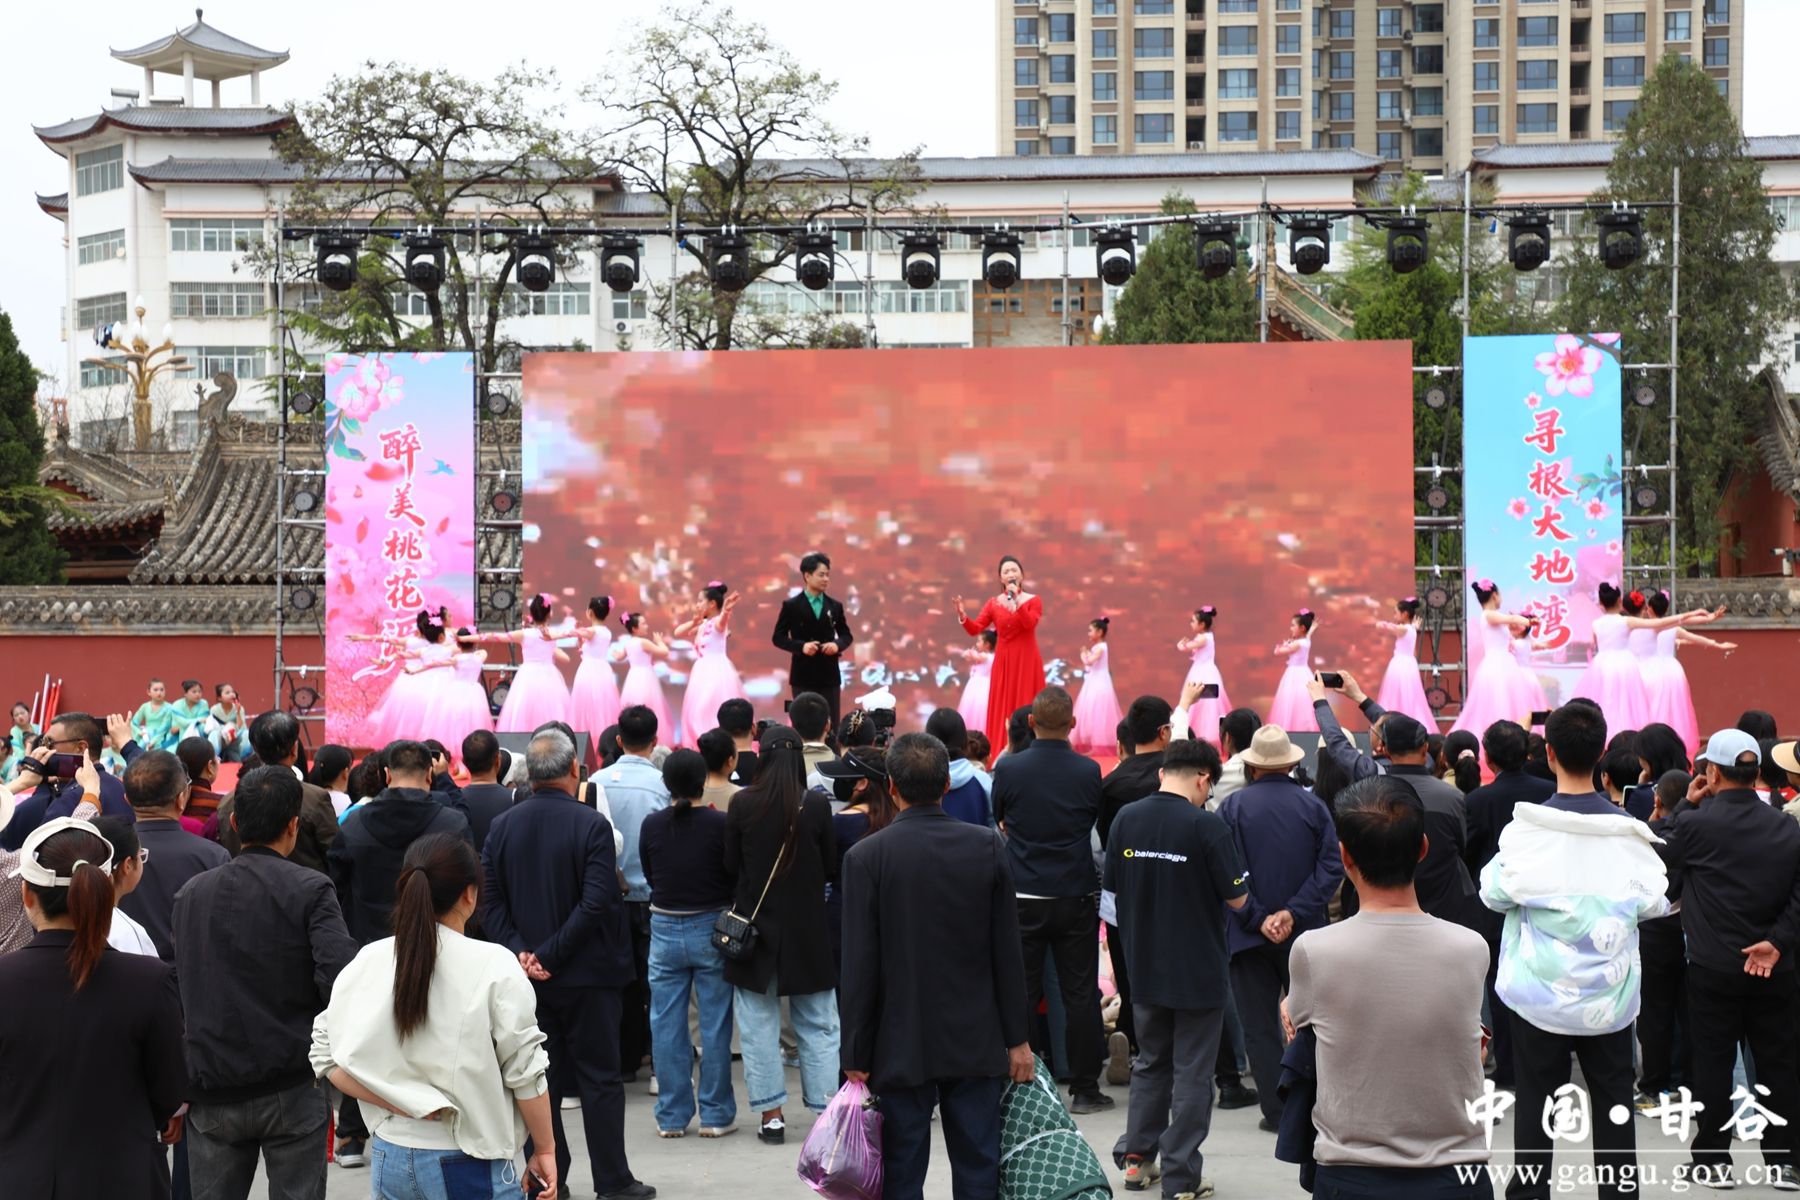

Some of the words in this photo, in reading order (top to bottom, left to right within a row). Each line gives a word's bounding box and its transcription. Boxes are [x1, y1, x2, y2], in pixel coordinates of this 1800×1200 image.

[1523, 407, 1576, 652] 寻根大地湾
